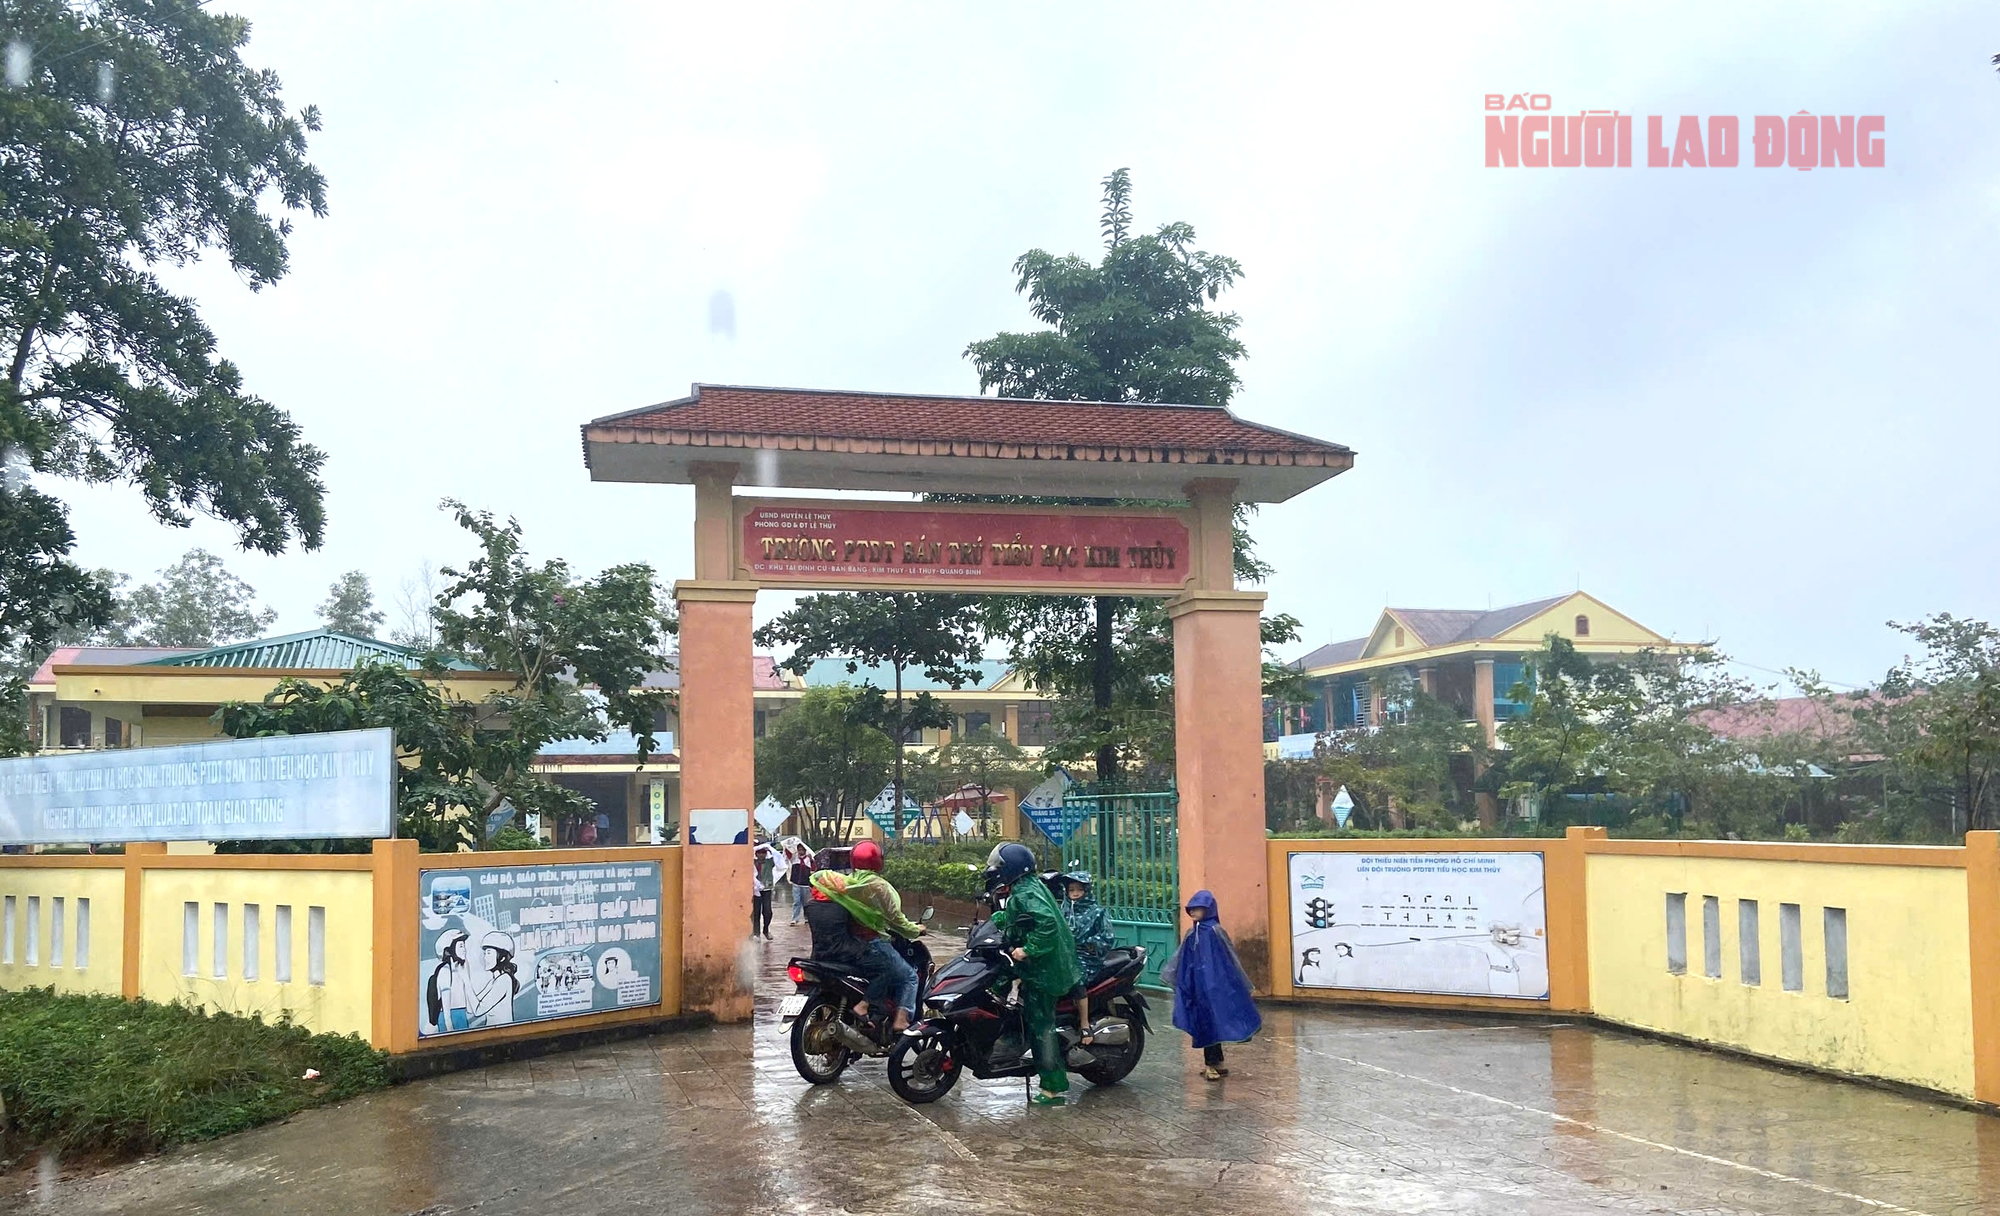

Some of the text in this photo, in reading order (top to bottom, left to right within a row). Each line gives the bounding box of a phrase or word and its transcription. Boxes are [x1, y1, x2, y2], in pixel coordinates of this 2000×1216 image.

[761, 533, 837, 562] TRƯỜNG
[844, 540, 896, 563] PTDT
[902, 534, 942, 564] BÁN
[948, 535, 983, 565] TRÚ
[991, 533, 1034, 566] TIỂU
[1041, 544, 1078, 571] HỌC
[1084, 545, 1120, 568] KIM
[137, 765, 158, 788] SINH
[200, 760, 222, 784] PTDT
[296, 753, 318, 785] HỌC
[181, 802, 194, 826] AN
[224, 800, 247, 824] GIAO
[250, 795, 284, 823] THÔNG
[606, 867, 616, 878] VÀ
[634, 867, 651, 877] SINH
